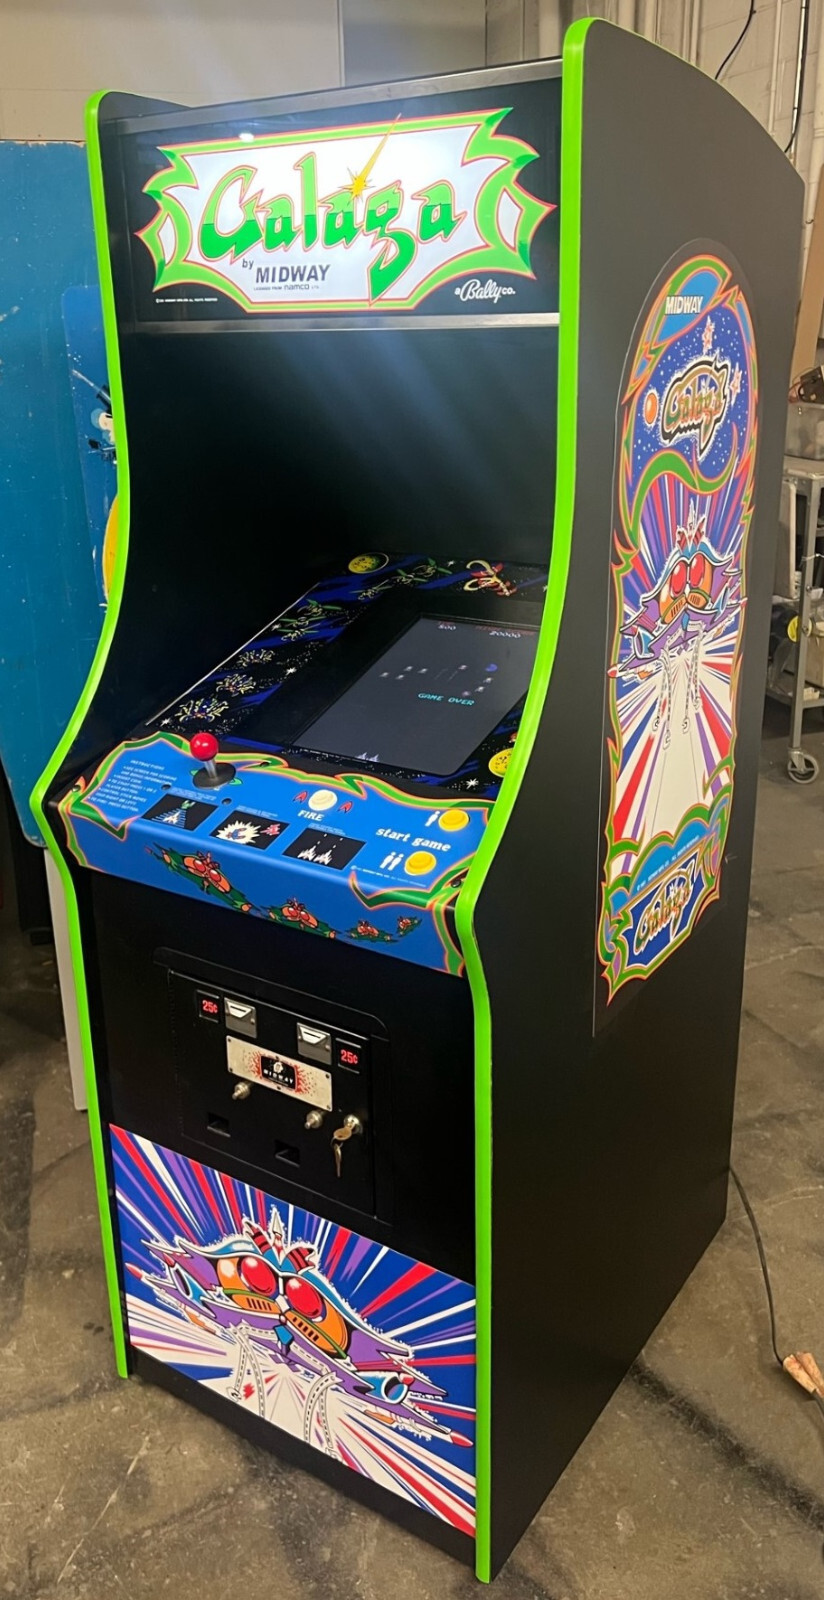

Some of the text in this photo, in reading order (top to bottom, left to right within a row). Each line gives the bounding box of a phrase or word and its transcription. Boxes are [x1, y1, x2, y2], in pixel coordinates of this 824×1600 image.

[198, 152, 467, 305] Galaga
[242, 258, 331, 283] by MIDWAY
[284, 283, 310, 291] namco
[460, 279, 502, 304] Bally
[665, 295, 704, 315] MIDWAY
[664, 364, 727, 450] Galaga
[489, 630, 521, 639] 20000
[418, 692, 475, 706] GAME OVER
[297, 809, 325, 822] FIRE
[375, 827, 451, 853] start game
